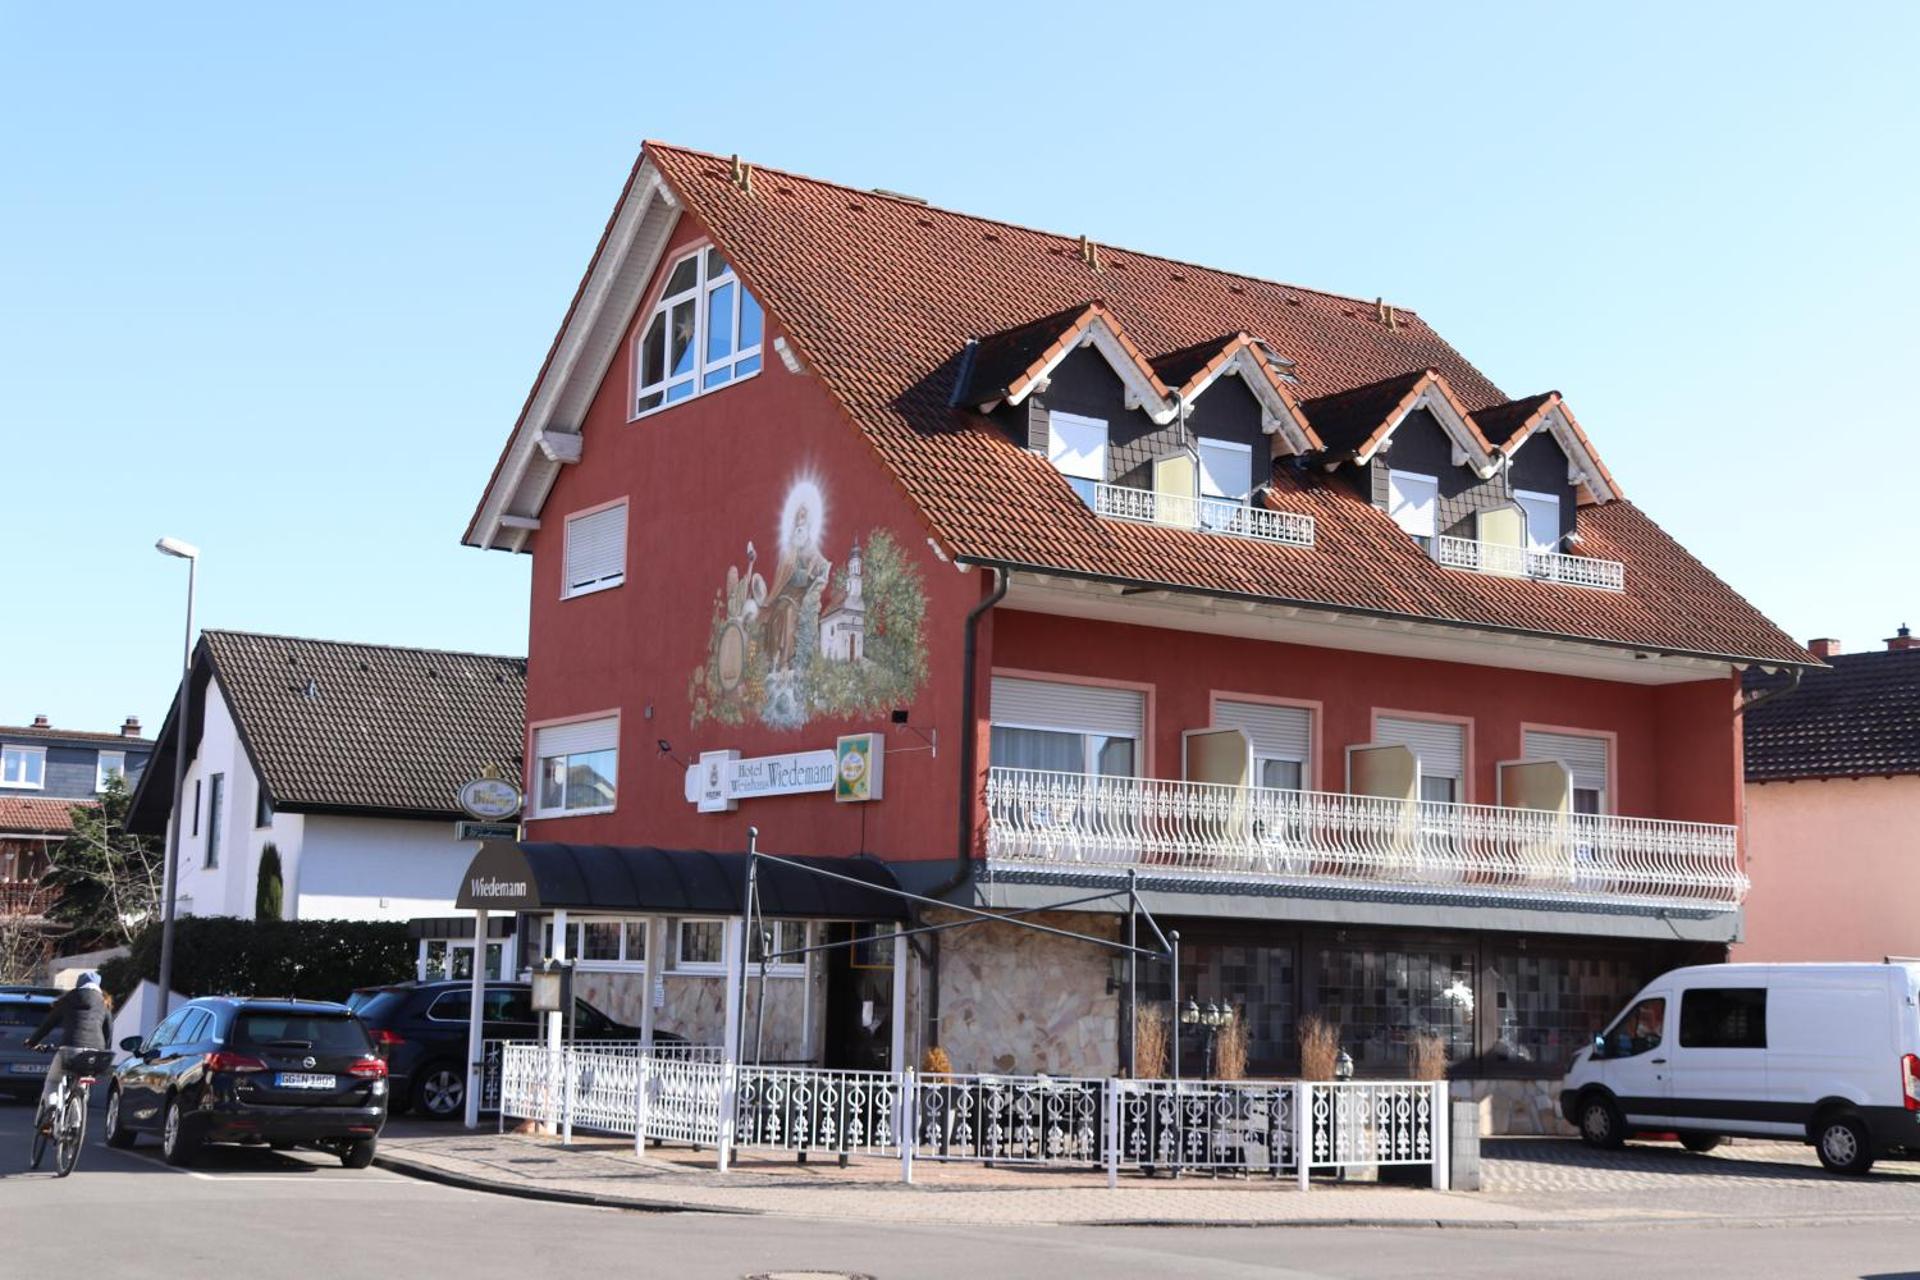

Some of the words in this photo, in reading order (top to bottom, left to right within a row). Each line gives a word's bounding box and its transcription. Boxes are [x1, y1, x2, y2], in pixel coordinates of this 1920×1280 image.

[738, 763, 763, 778] Hotel
[767, 759, 834, 788] Wiedemann
[471, 876, 527, 897] Wiedemann
